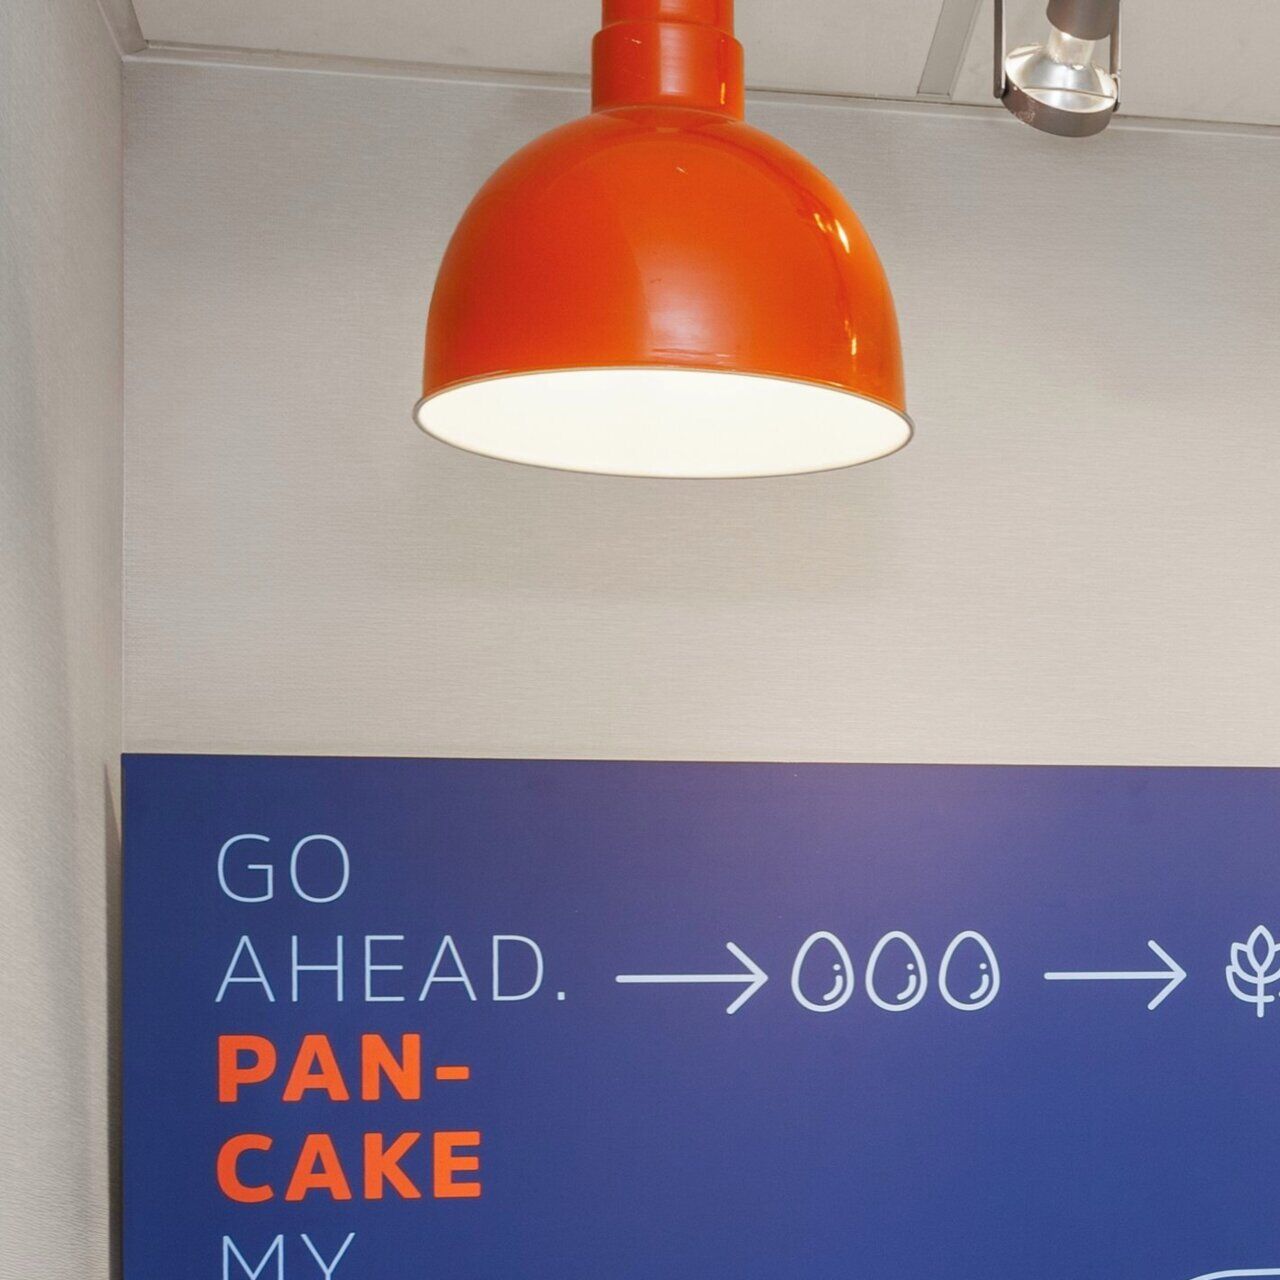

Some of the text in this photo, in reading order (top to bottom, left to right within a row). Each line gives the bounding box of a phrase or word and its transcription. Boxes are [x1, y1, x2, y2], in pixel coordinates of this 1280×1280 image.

[216, 832, 352, 905] GO
[214, 934, 567, 1003] AHEAD.
[216, 1032, 471, 1104] PAN-
[215, 1129, 482, 1205] CAKE
